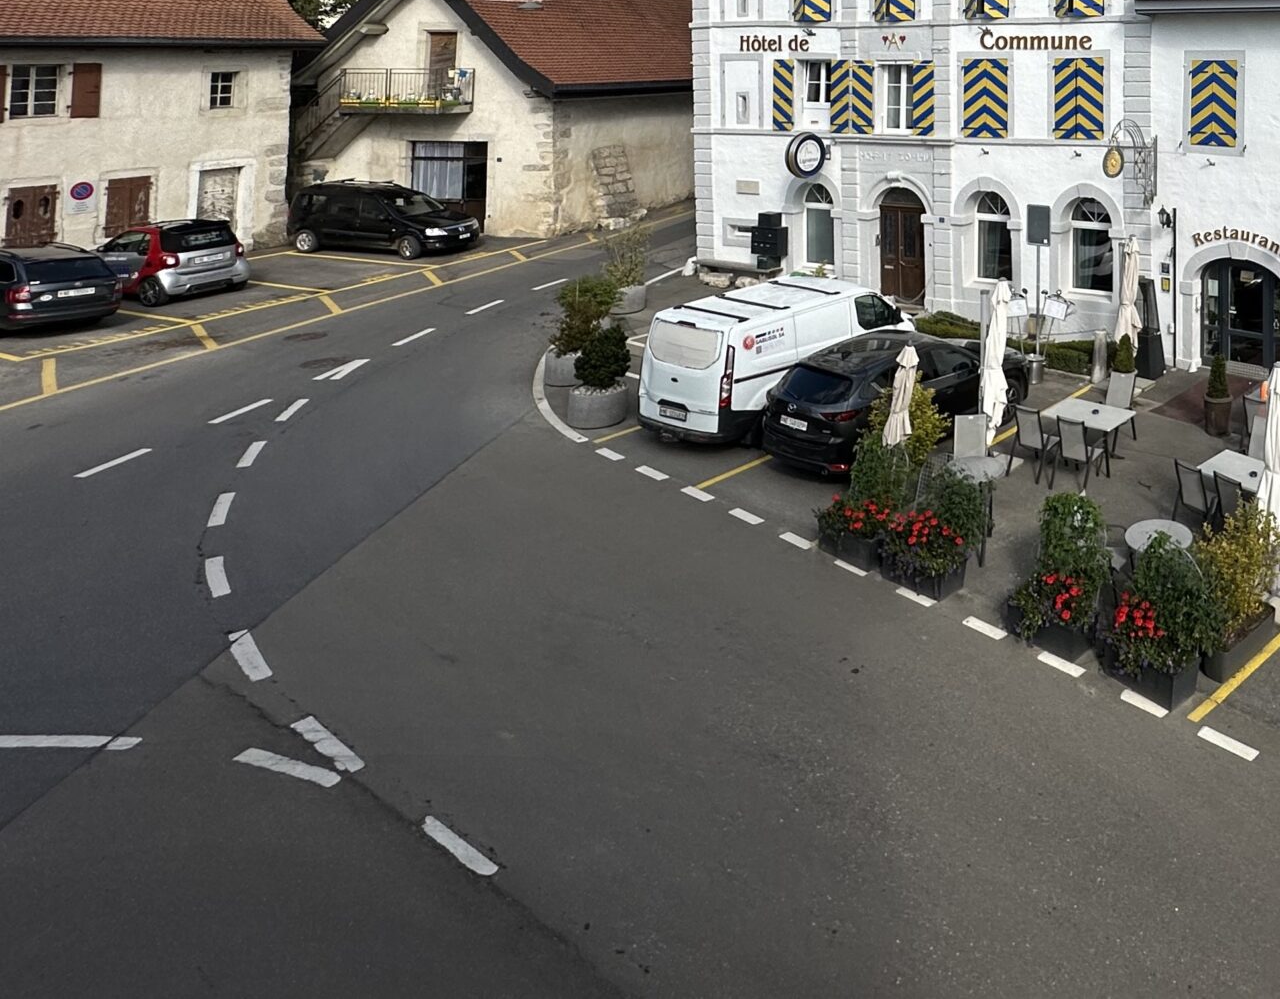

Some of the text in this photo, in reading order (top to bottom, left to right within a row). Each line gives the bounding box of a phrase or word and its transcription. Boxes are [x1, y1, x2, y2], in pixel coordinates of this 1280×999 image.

[739, 34, 810, 52] Hôtel de
[980, 30, 1093, 50] Commune
